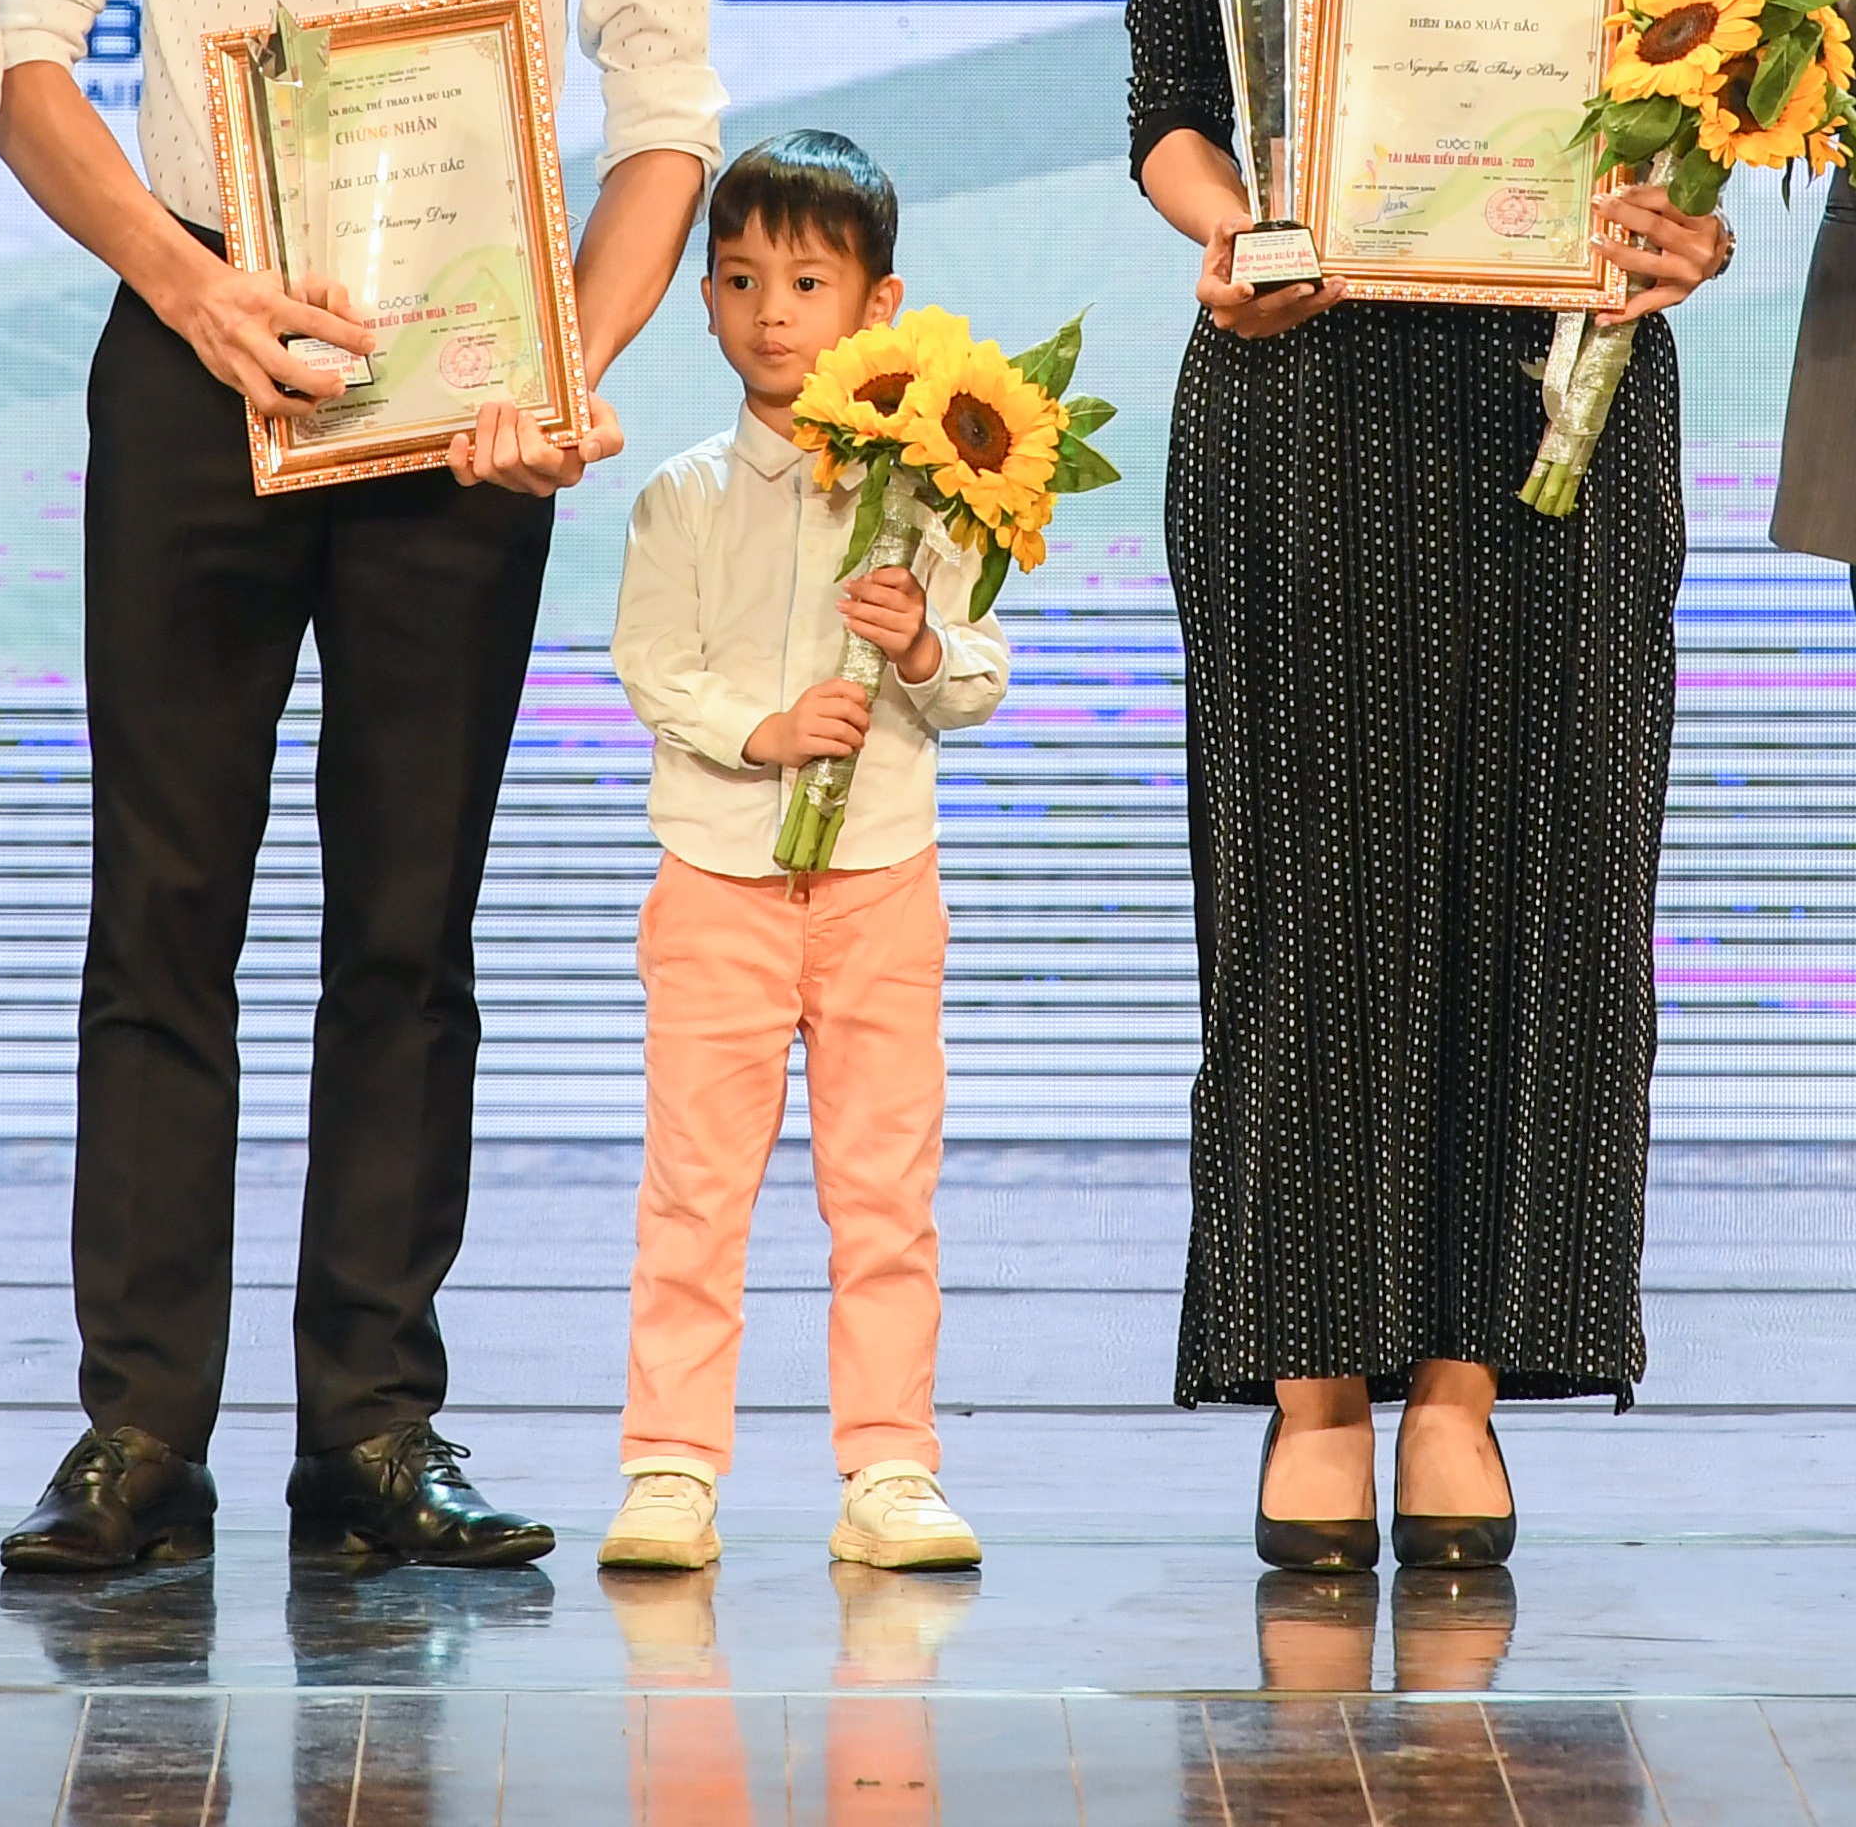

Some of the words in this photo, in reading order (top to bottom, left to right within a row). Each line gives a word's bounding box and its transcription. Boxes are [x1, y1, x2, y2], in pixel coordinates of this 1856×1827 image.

[1475, 18, 1511, 31] XUẤT
[386, 96, 410, 108] THAO
[394, 115, 438, 136] NHẬN
[1436, 138, 1471, 152] CUỘC
[1512, 157, 1535, 168] 2020
[357, 170, 399, 187] LUYN
[402, 161, 437, 179] XUẤT
[455, 302, 478, 316] 2020
